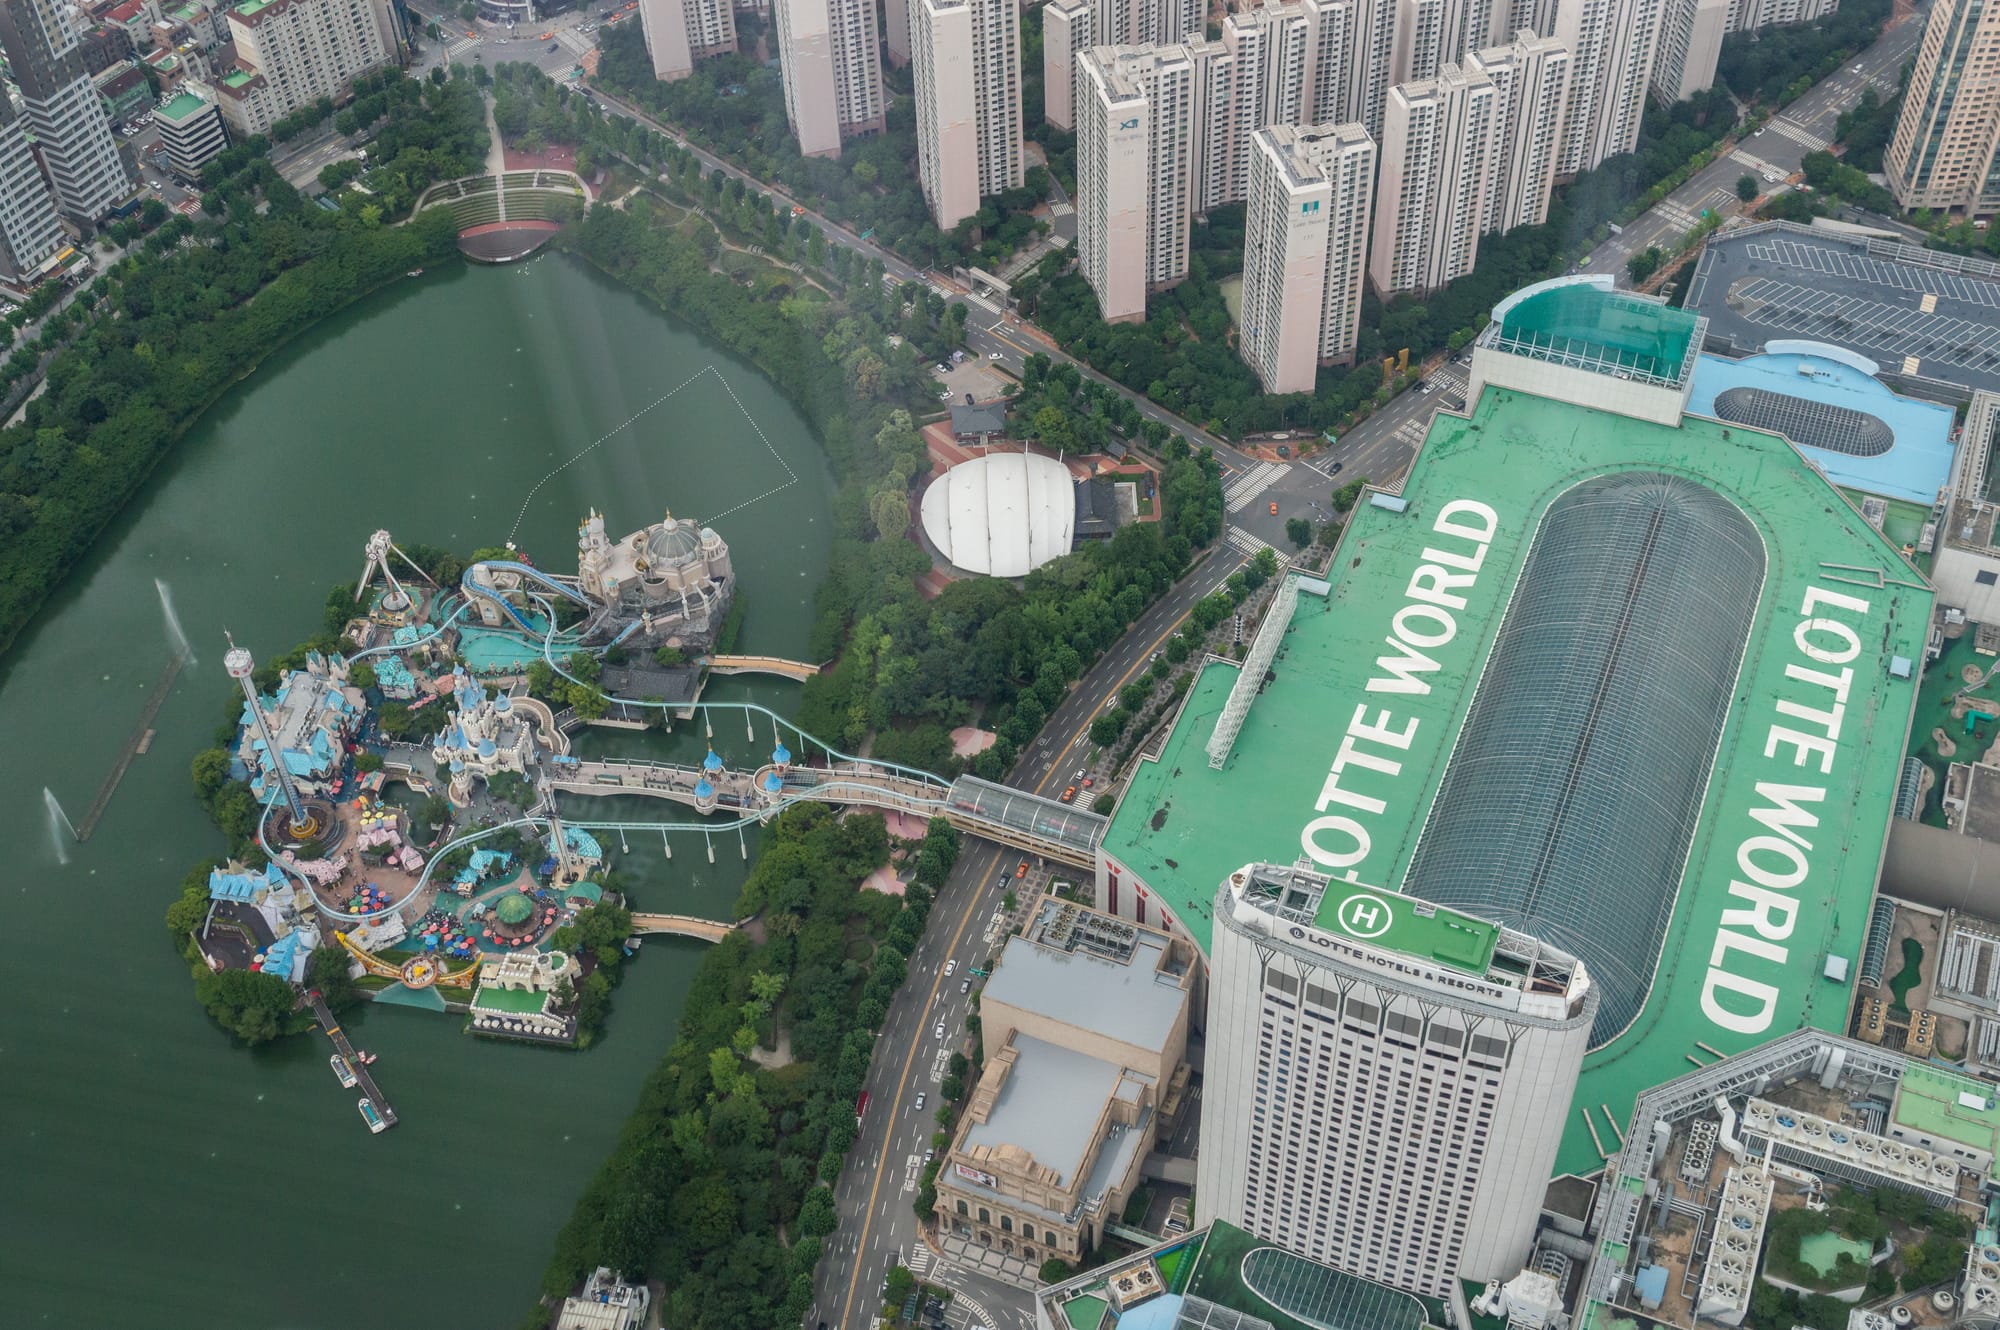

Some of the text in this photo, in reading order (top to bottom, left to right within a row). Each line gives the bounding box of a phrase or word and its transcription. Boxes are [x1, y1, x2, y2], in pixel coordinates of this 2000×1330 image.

[1301, 499, 1499, 882] OTTE WORLD
[1352, 904, 1379, 929] H
[1700, 586, 1870, 1034] LOTTE WORLD
[1309, 934, 1503, 998] LOTTE HOTELS & RESORTS
